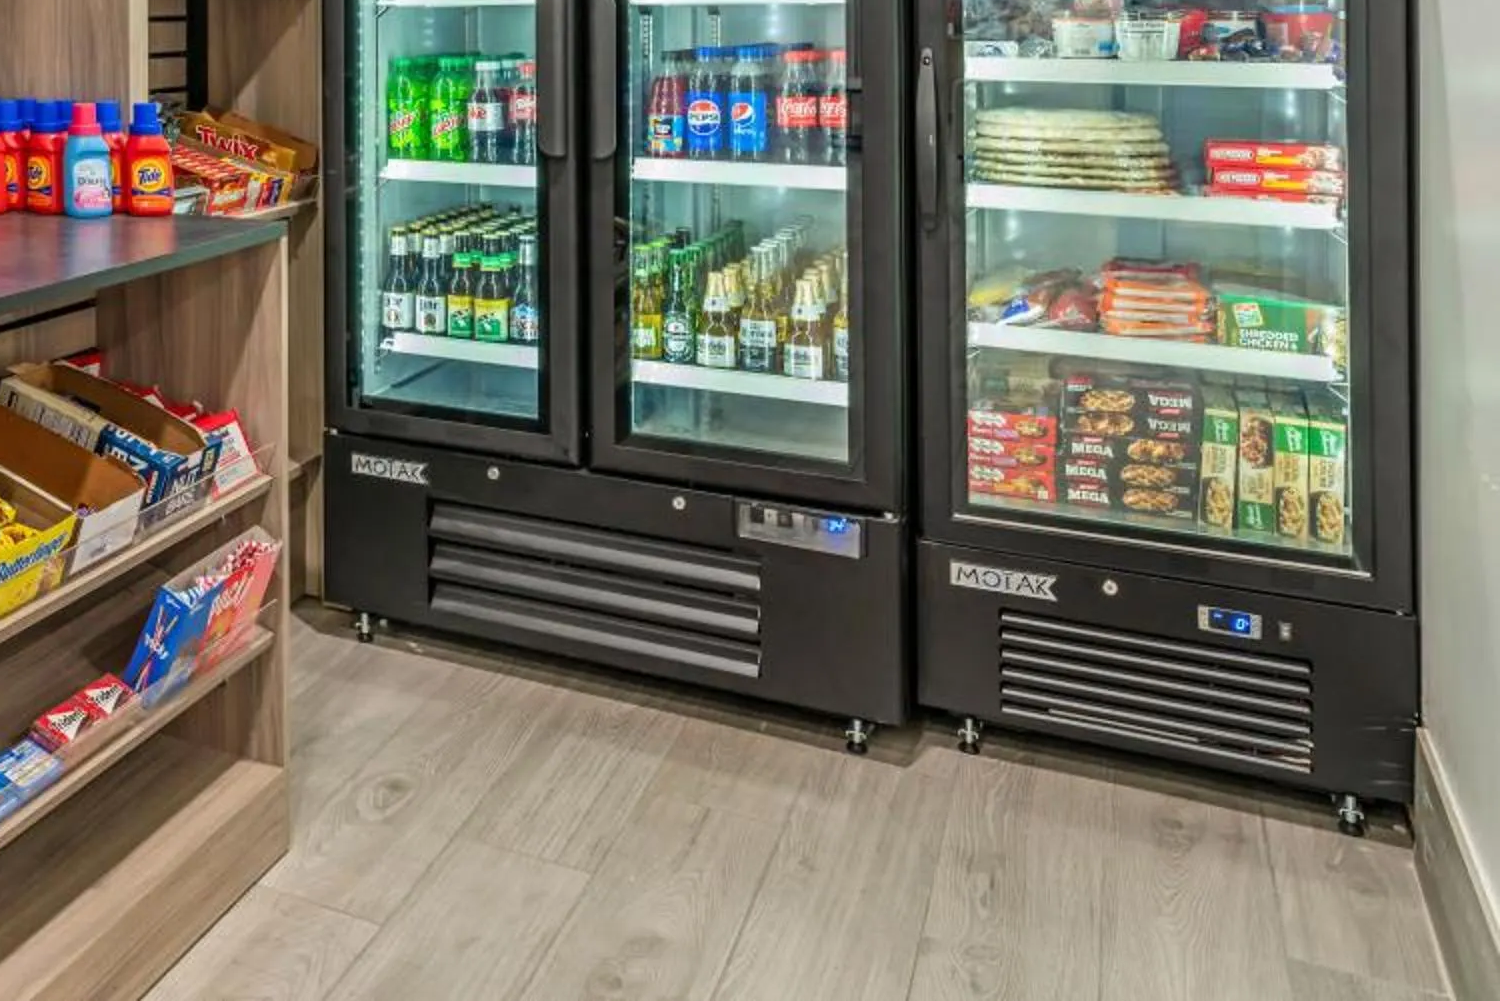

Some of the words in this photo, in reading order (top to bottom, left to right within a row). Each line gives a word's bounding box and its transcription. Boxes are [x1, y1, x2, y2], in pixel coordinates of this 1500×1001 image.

[138, 168, 162, 185] Tide
[1071, 442, 1114, 458] MEGA
[355, 456, 422, 482] MOTAK
[1065, 464, 1108, 482] MEGA
[1067, 488, 1110, 504] MEGA
[956, 566, 1050, 596] MOTAK
[52, 708, 86, 731] Trident
